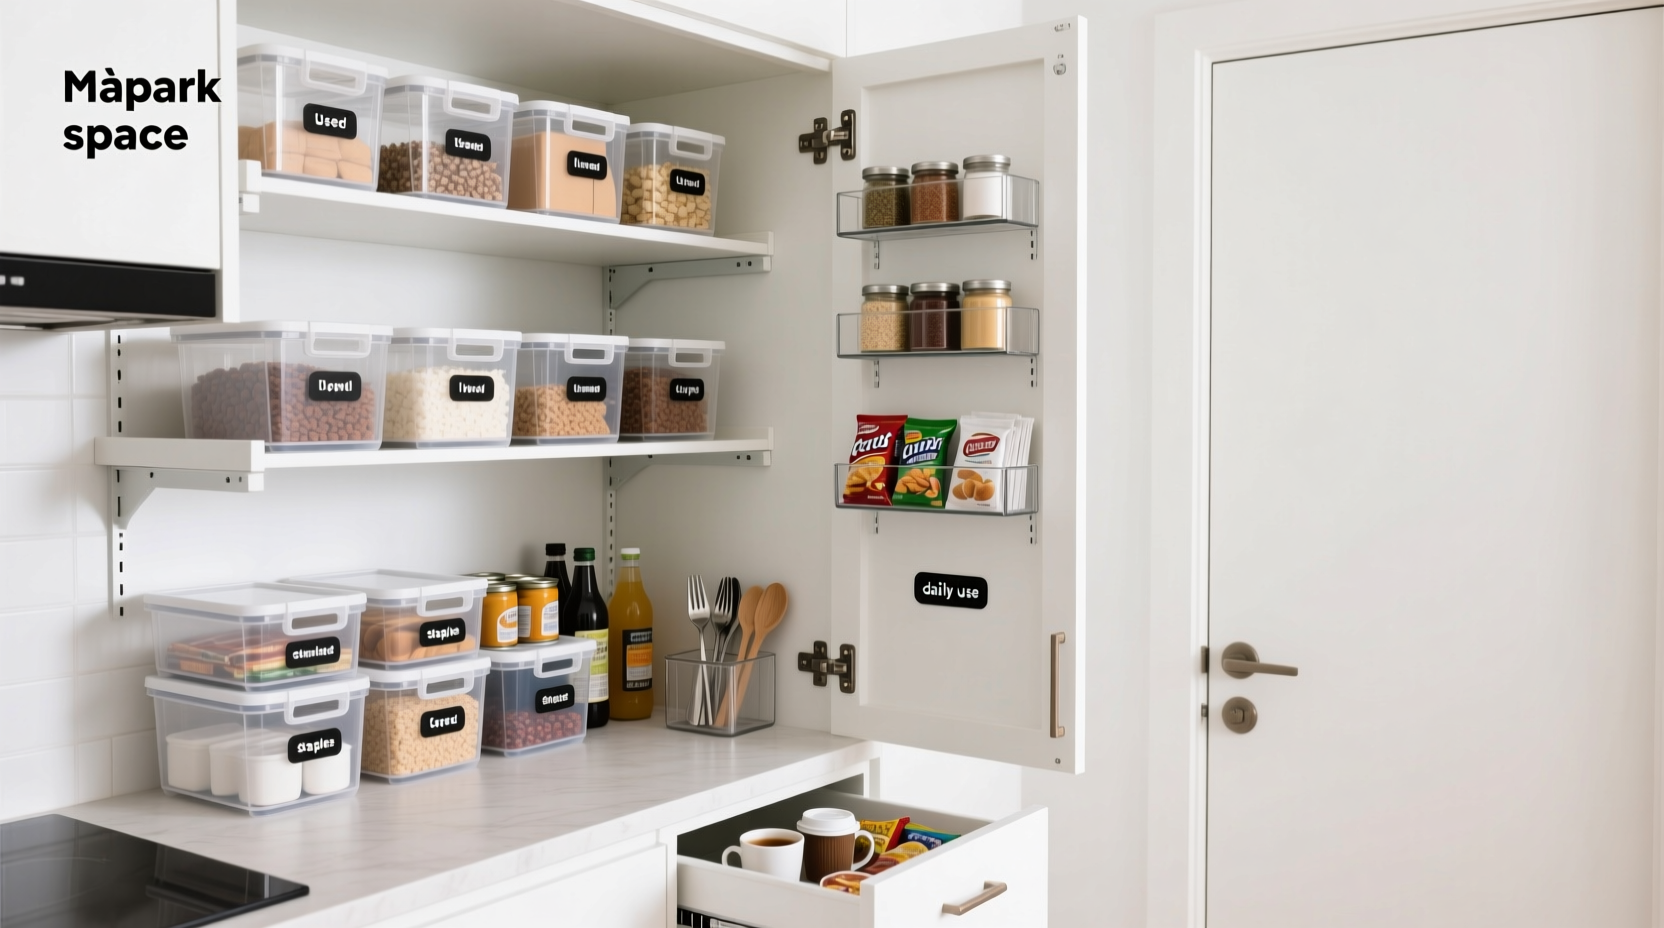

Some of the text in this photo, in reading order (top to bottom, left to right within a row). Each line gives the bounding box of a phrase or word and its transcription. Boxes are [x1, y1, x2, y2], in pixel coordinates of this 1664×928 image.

[314, 112, 347, 129] Used
[922, 581, 979, 600] daily use
